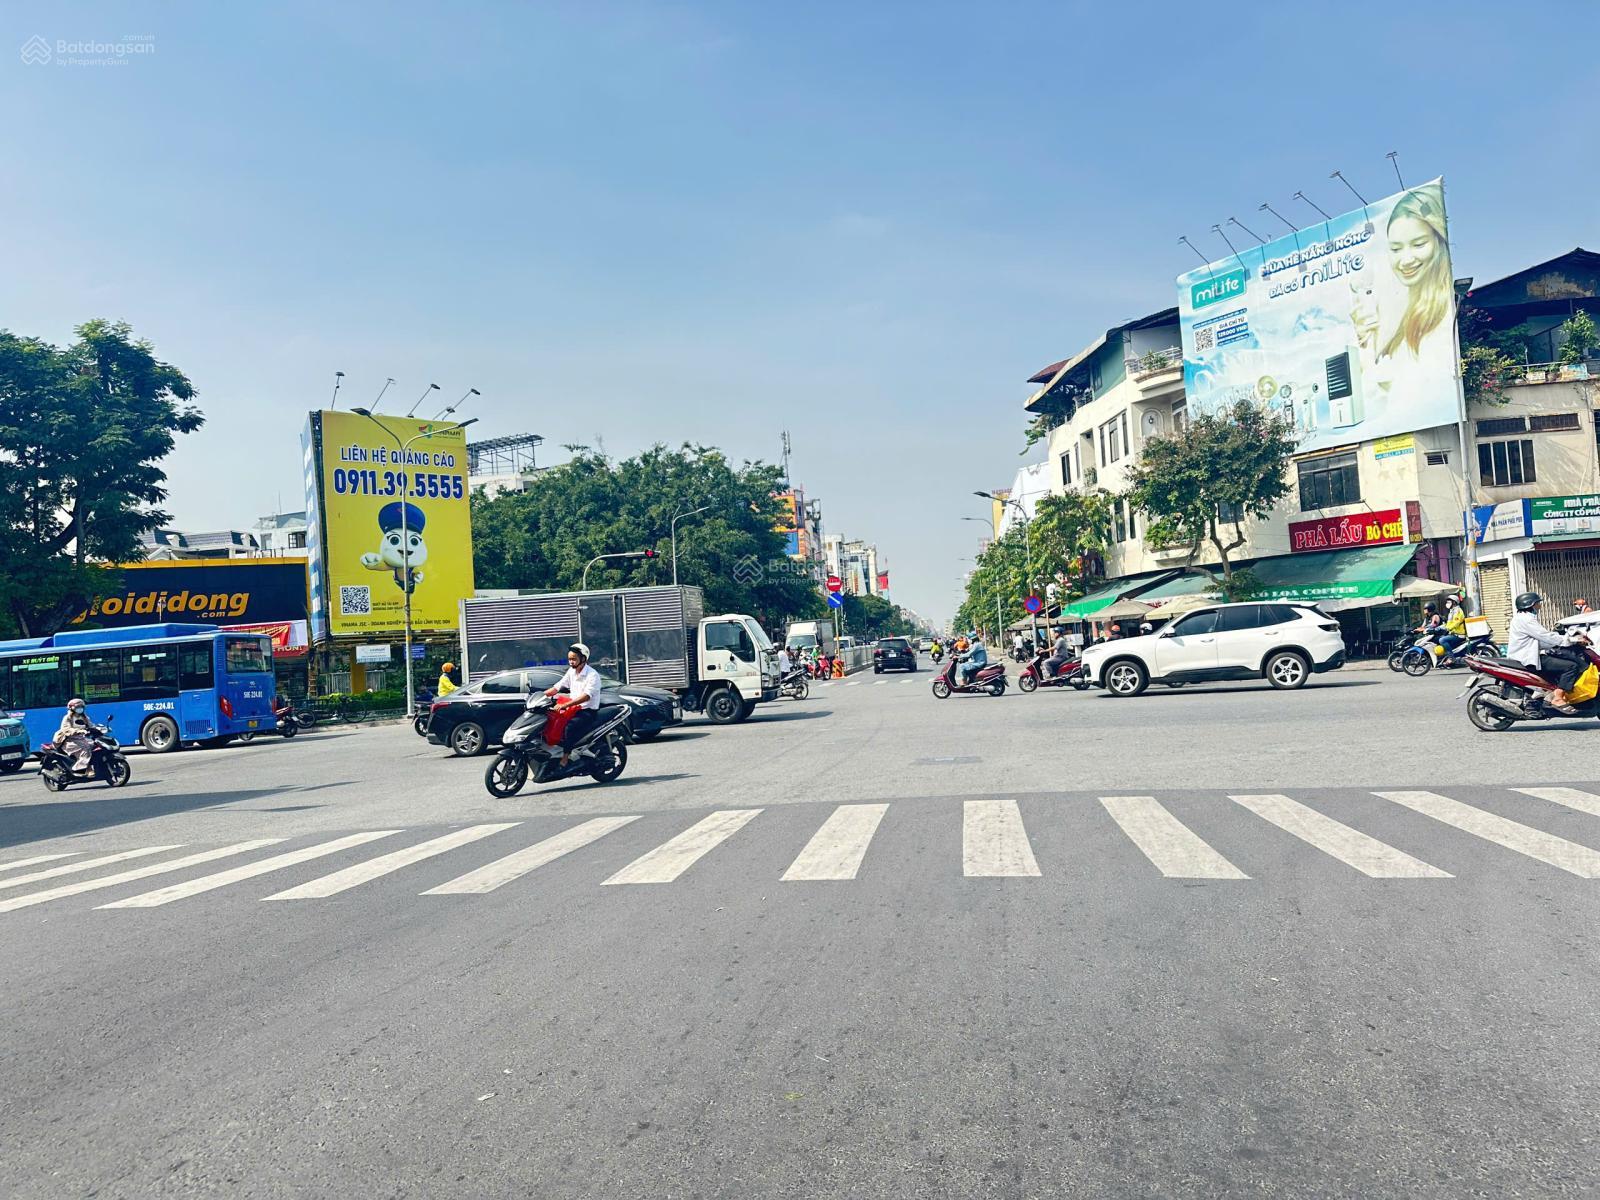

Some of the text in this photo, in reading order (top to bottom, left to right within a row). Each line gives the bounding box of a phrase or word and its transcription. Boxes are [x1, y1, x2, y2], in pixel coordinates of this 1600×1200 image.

[1284, 251, 1300, 268] HÈ
[1335, 231, 1371, 251] NÓNG
[1284, 279, 1299, 294] CÓ
[1301, 253, 1364, 288] miLife
[1196, 278, 1239, 303] miLife
[341, 444, 455, 468] LIÊN HỆ QUẢNG CÁO
[333, 468, 463, 499] 0911.39.5555
[1583, 495, 1600, 506] PHÂ
[1295, 517, 1403, 548] PHÁ LẤU BÒ CHÉ
